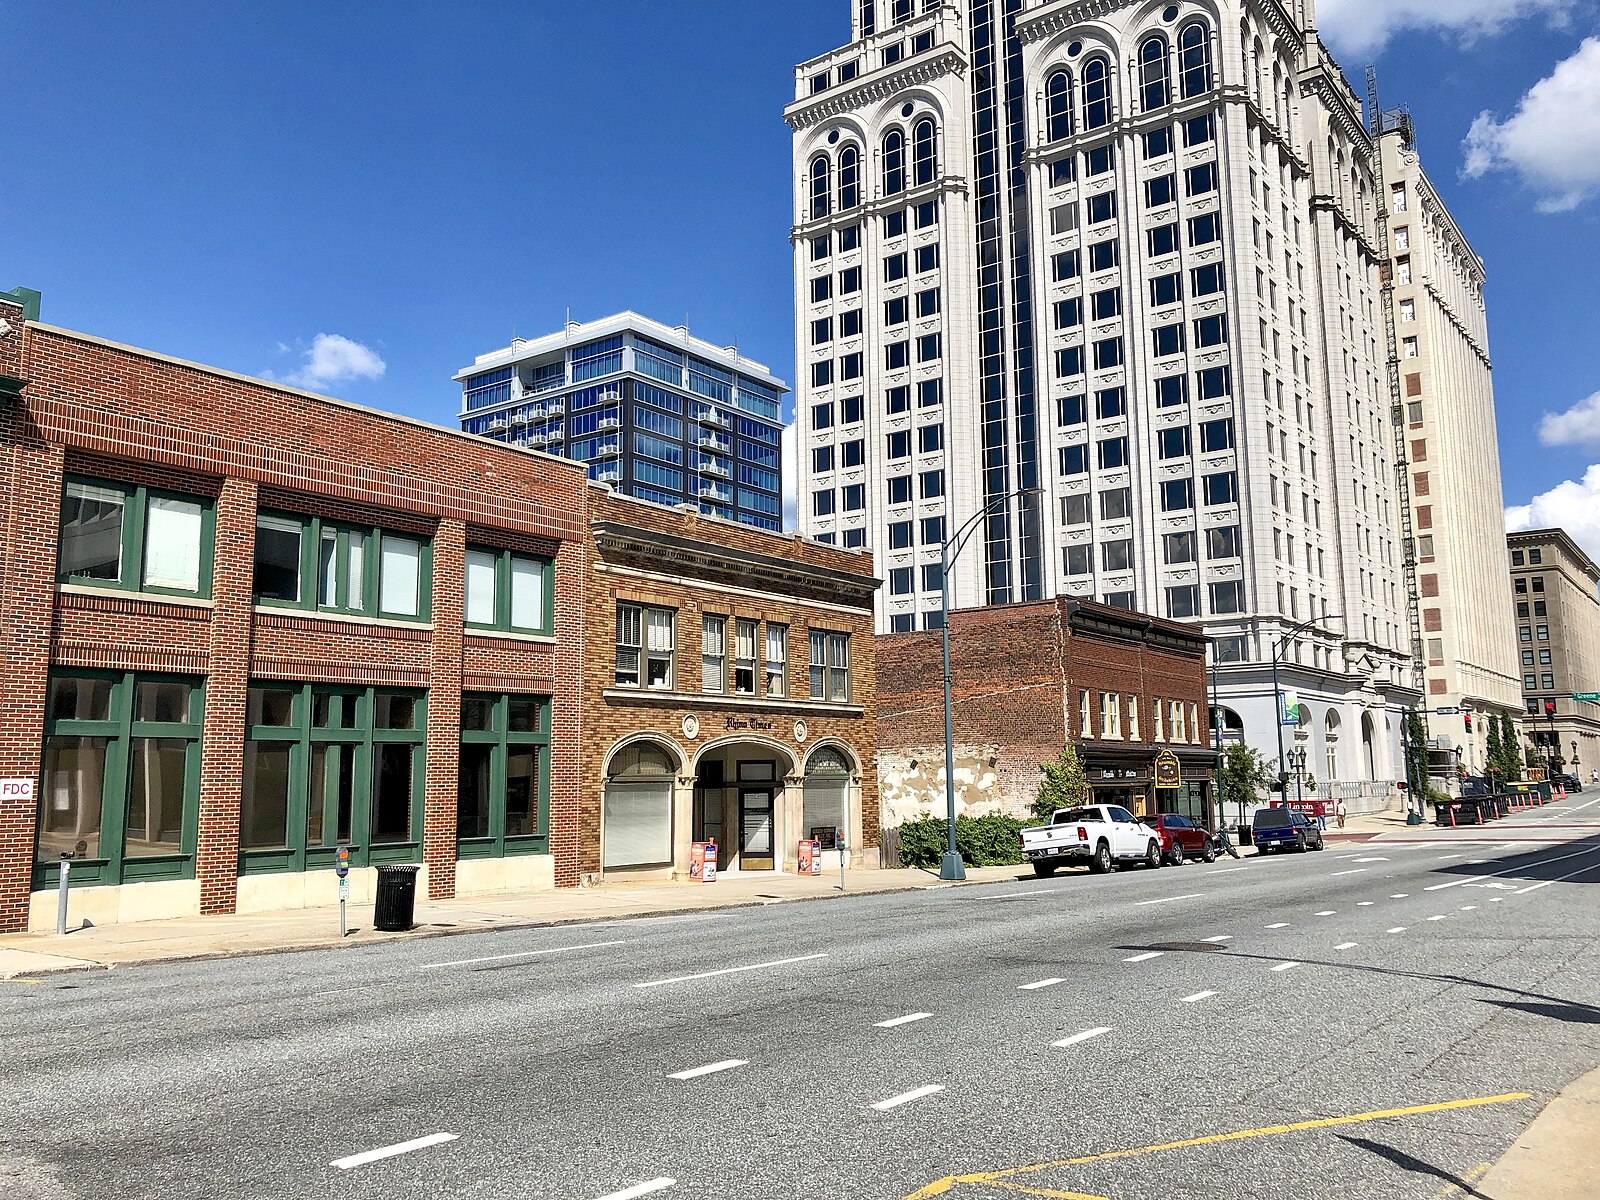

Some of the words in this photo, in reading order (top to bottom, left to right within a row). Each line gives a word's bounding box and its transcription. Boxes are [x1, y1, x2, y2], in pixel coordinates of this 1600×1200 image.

[726, 717, 748, 731] Rhino
[750, 718, 771, 730] Times
[3, 783, 30, 795] FDC
